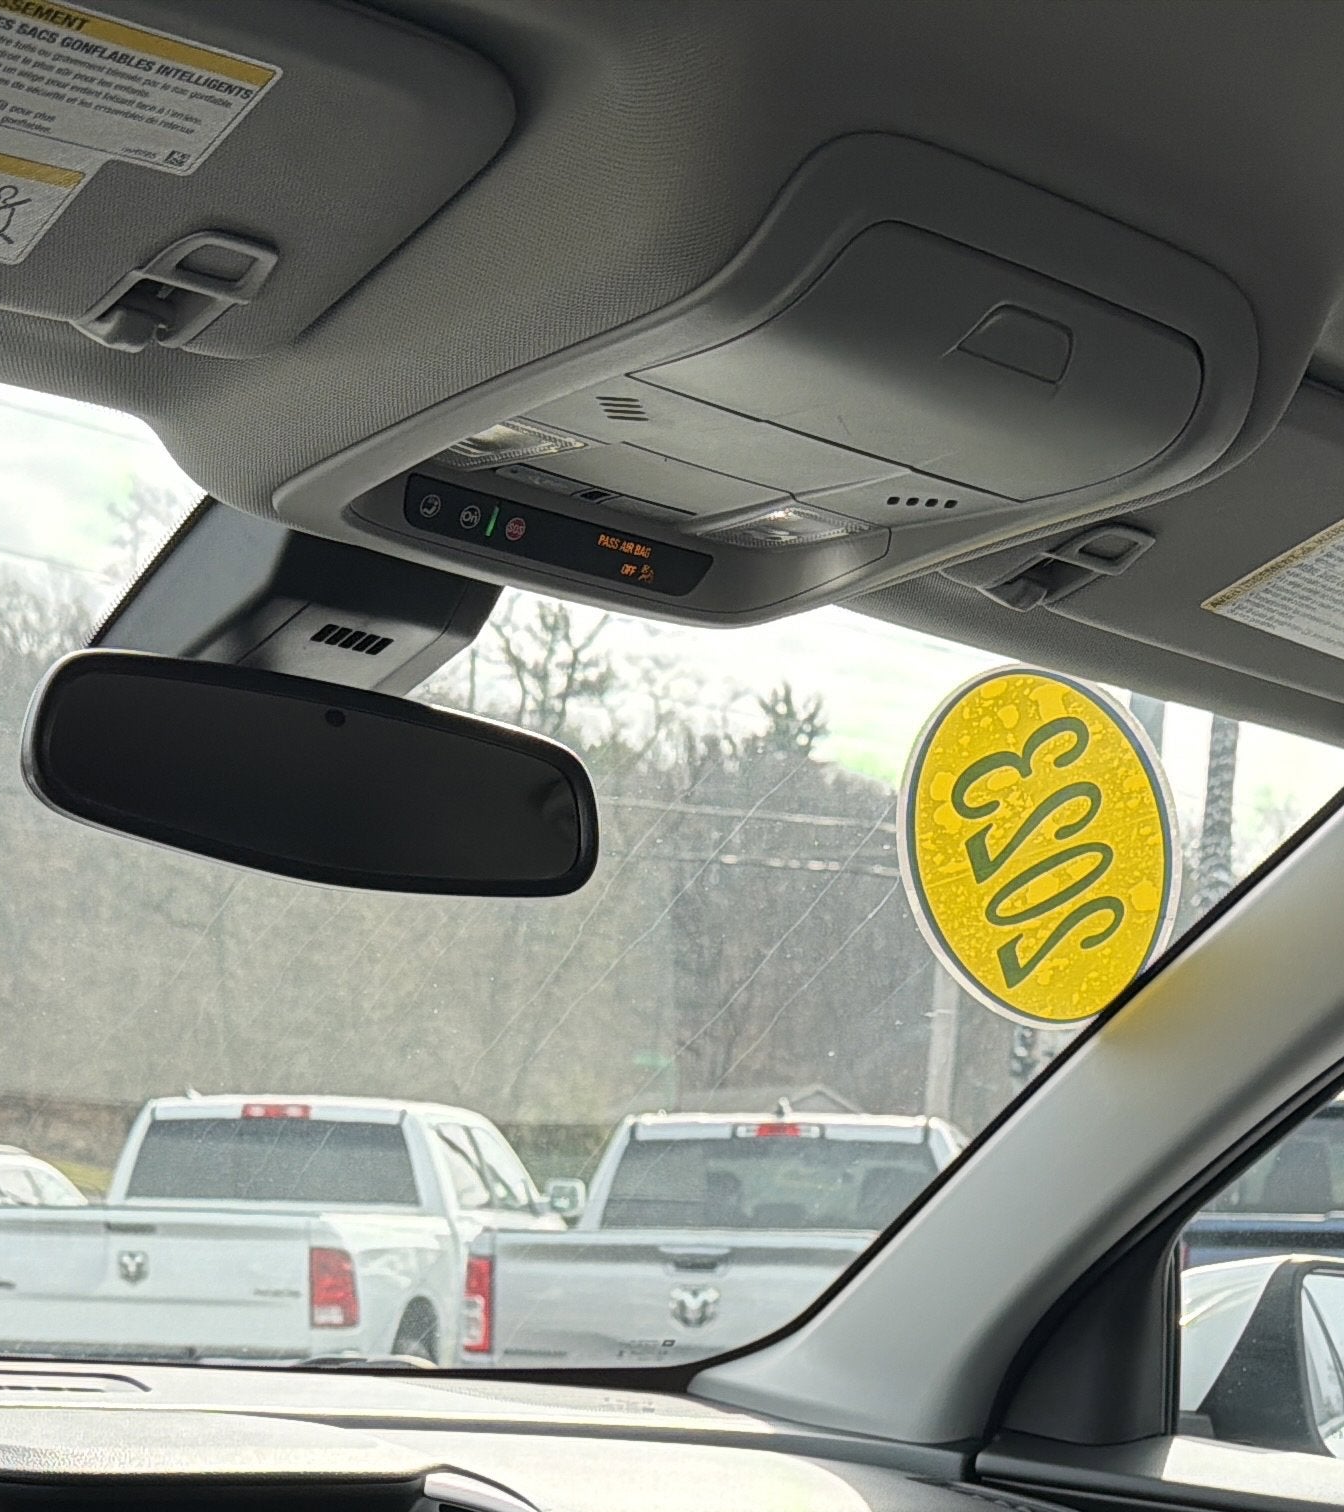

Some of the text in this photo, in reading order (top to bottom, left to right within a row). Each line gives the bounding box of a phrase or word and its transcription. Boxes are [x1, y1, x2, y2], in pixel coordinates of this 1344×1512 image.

[14, 22, 60, 43] SACS
[58, 36, 157, 71] GONFLABLES
[154, 63, 254, 99] INTELLIGENTS
[597, 534, 652, 558] PASS AIR BAG
[620, 563, 637, 576] OFF
